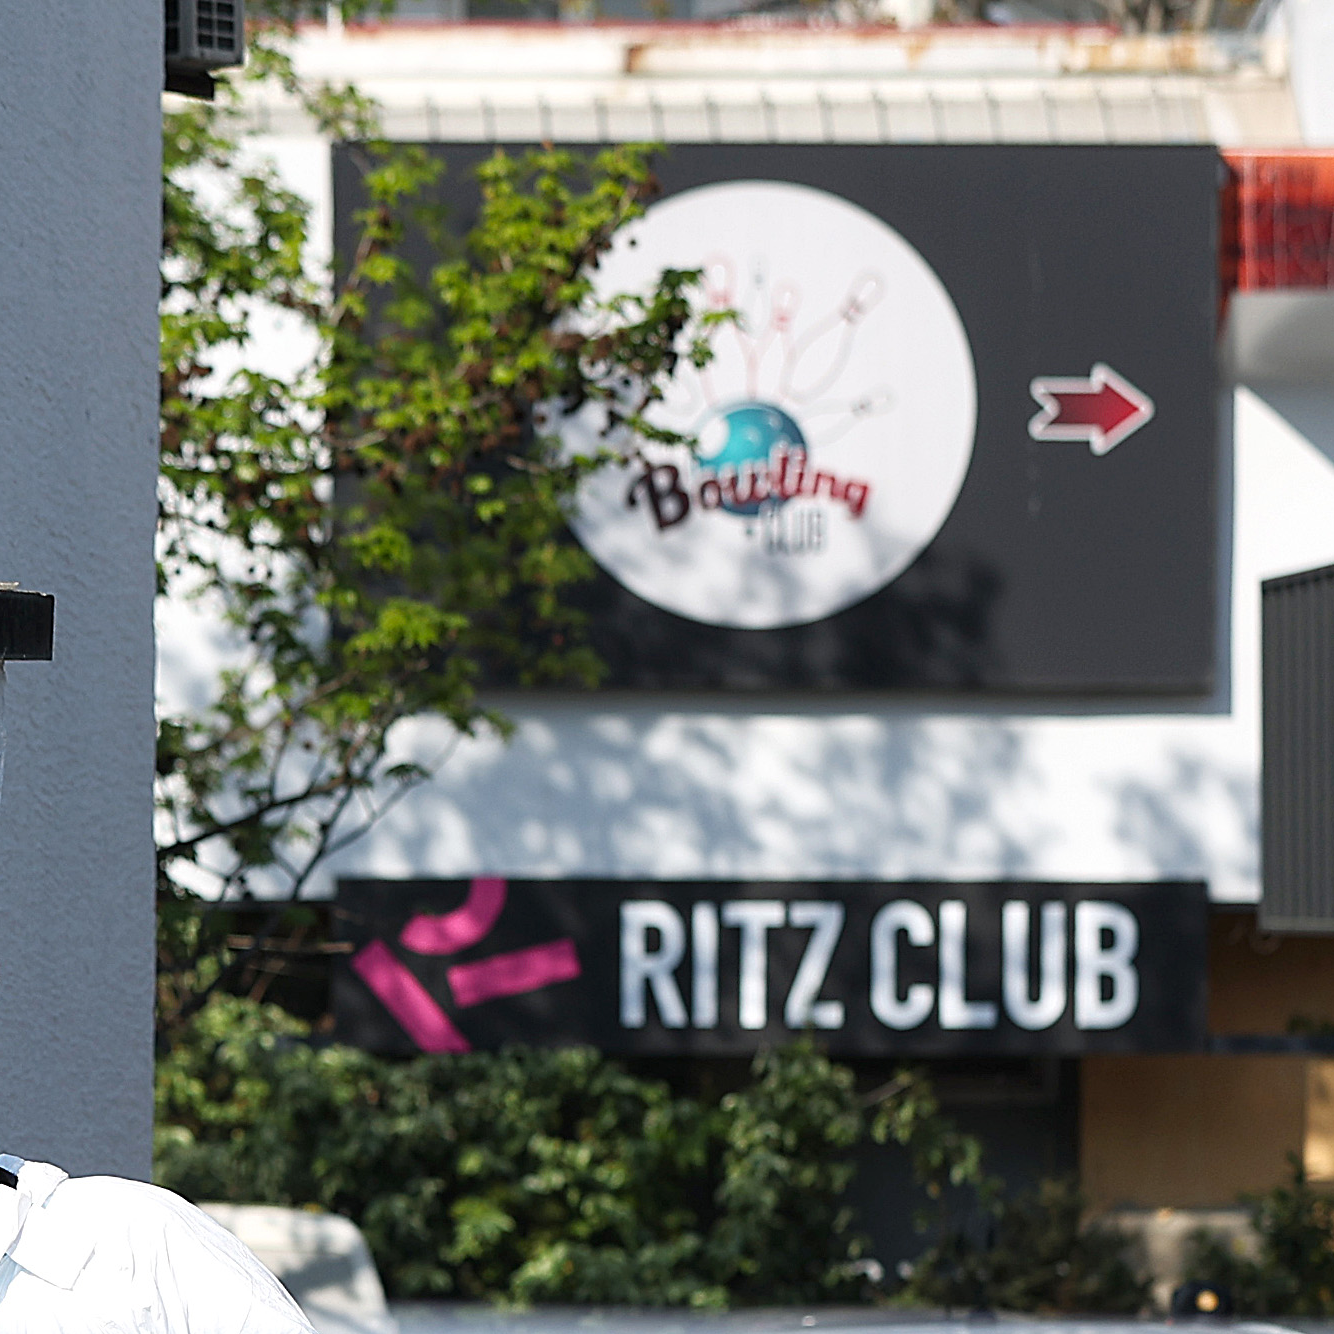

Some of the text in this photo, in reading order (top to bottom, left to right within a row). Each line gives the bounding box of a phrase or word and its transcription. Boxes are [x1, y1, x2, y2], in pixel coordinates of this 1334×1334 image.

[627, 445, 870, 530] Bowling
[619, 899, 1141, 1031] RITZ CLUB
